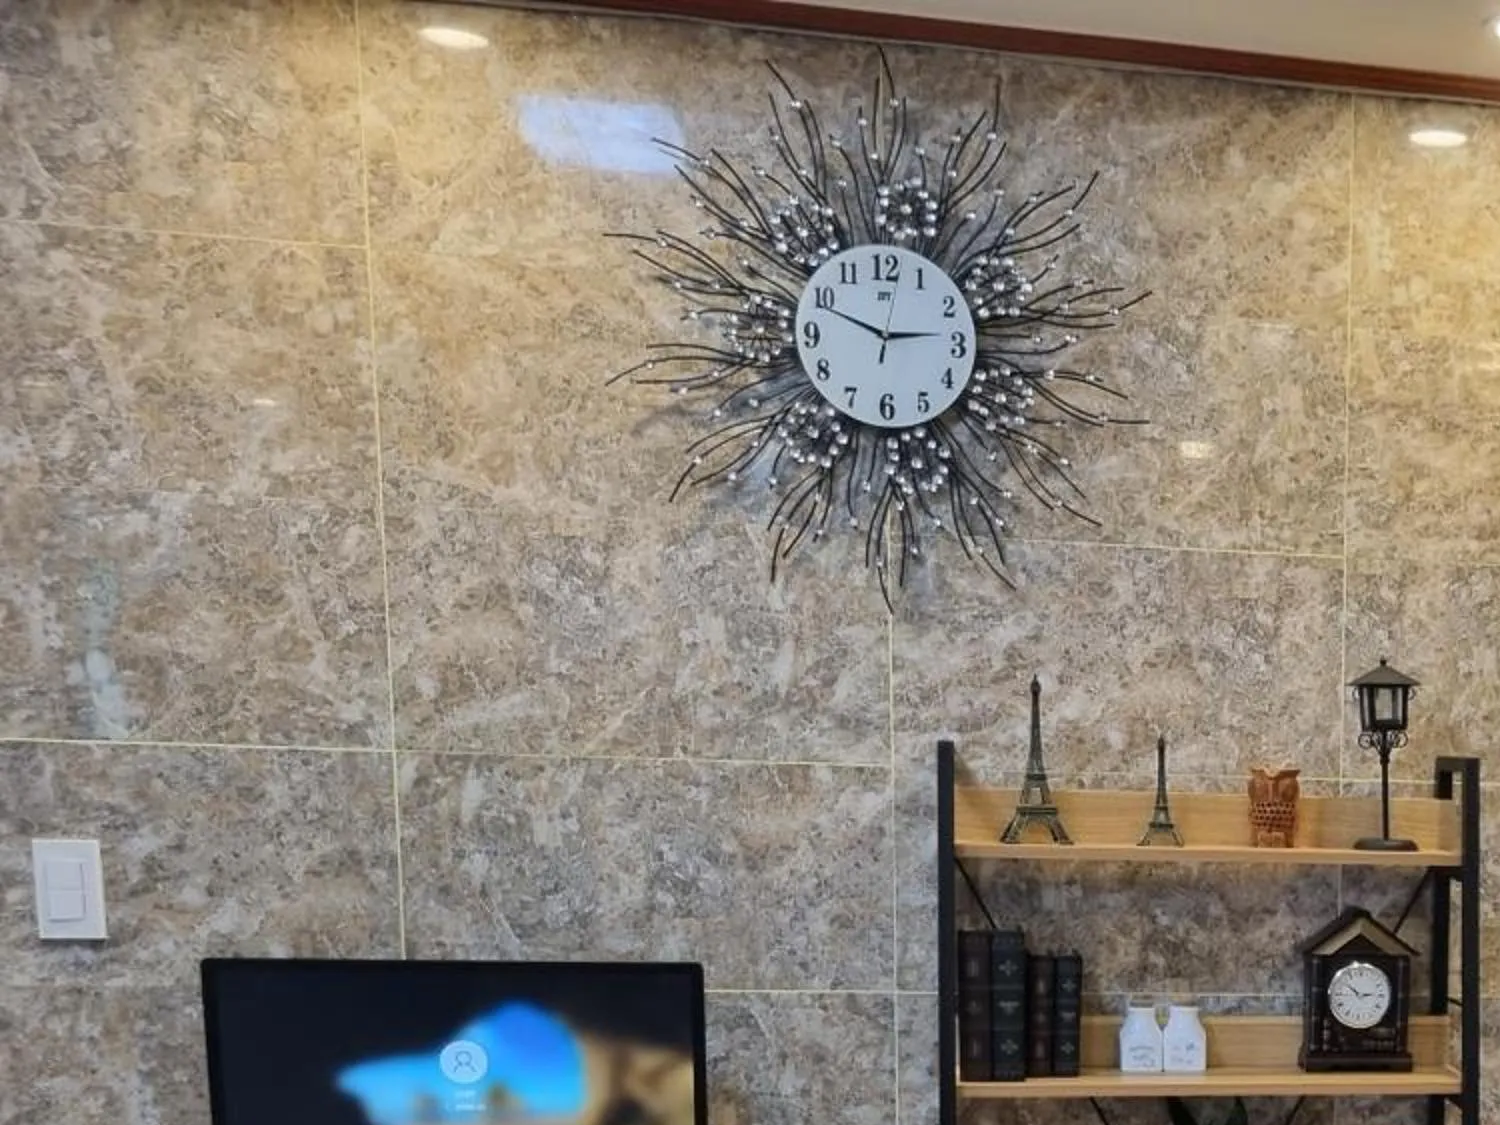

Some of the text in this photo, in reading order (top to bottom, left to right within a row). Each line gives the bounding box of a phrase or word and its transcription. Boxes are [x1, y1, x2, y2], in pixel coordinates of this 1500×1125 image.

[840, 262, 857, 285] 11
[872, 254, 899, 282] 12
[915, 268, 926, 291] 1
[814, 287, 835, 309] 10
[943, 296, 956, 319] 2
[803, 321, 821, 349] 9
[951, 331, 967, 359] 3
[816, 358, 831, 381] 8
[940, 367, 954, 389] 4
[843, 386, 858, 409] 7
[879, 393, 895, 421] 6
[917, 391, 930, 413] 5
